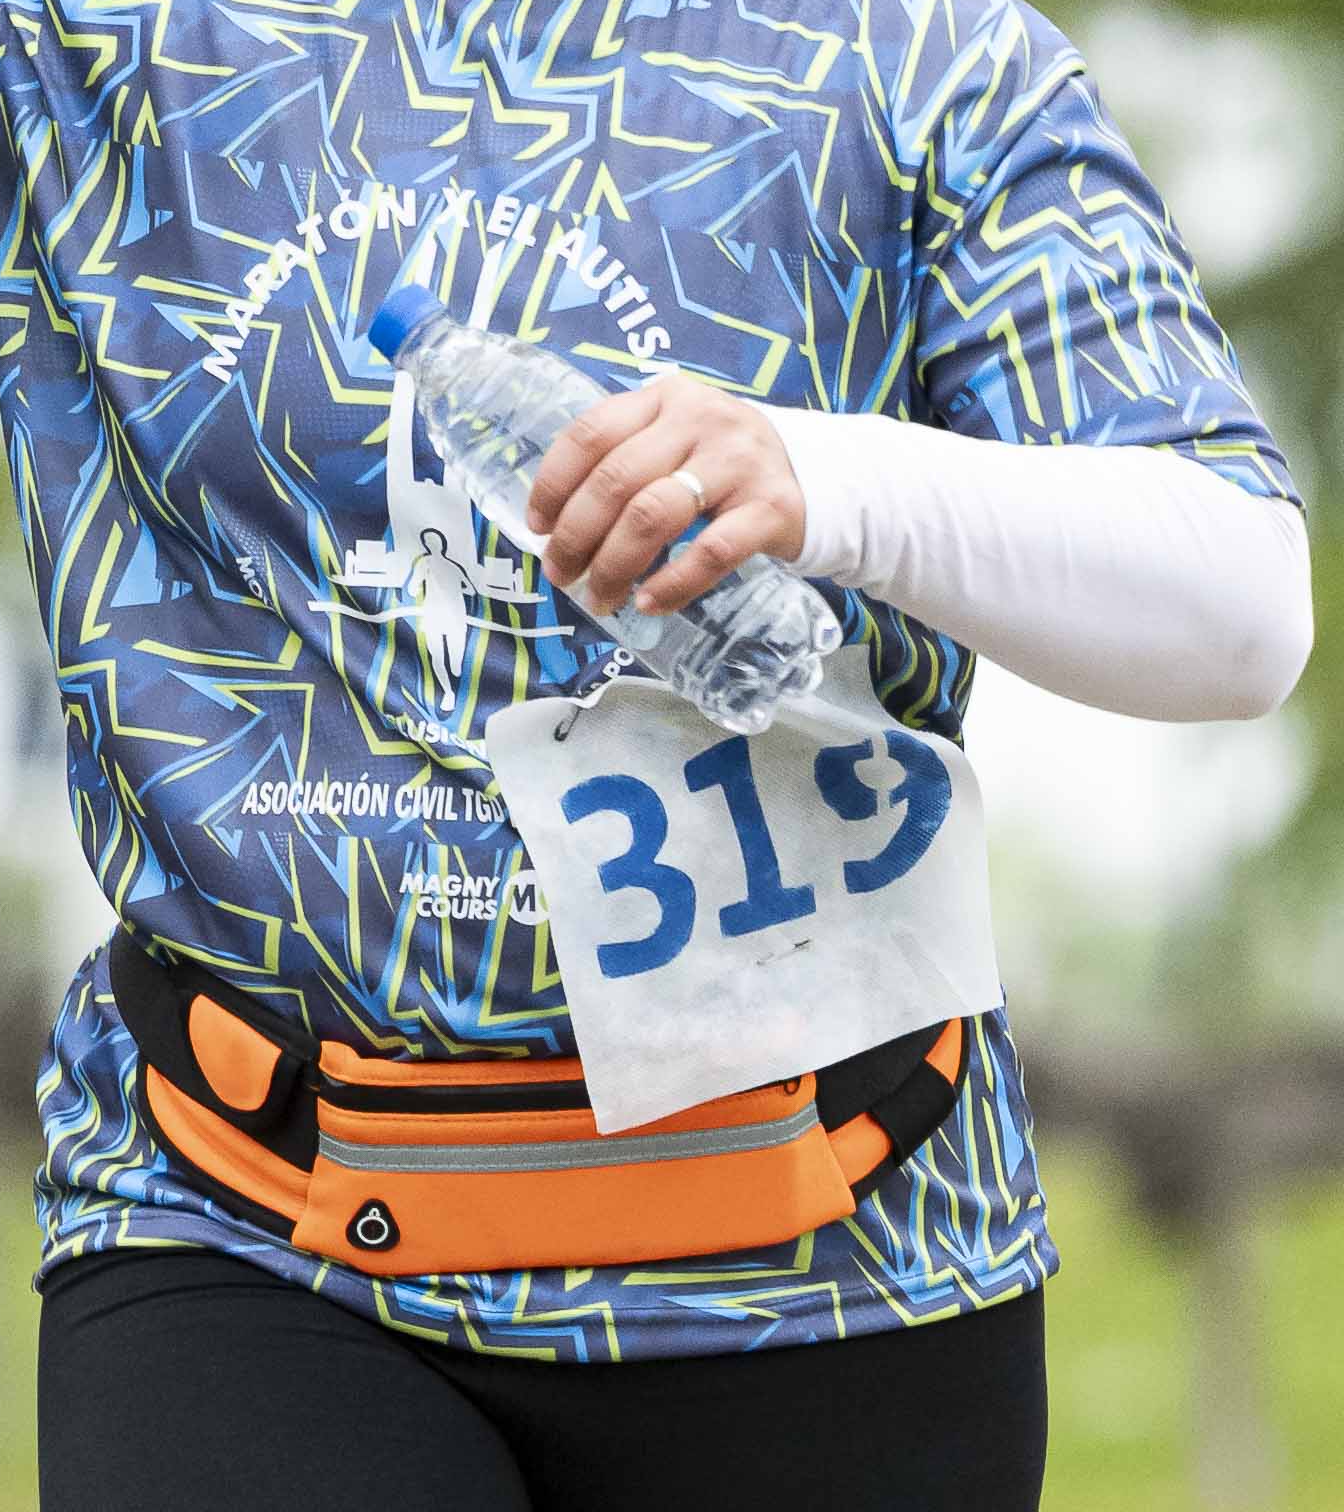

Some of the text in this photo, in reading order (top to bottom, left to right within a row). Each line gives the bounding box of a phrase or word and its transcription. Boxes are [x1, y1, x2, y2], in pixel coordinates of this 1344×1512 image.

[202, 188, 417, 384] MARATÓN
[435, 187, 476, 229] X
[486, 194, 536, 248] EL
[241, 772, 389, 817] ASOCIACIÓN
[394, 784, 458, 821] CIVIL
[560, 729, 952, 979] 319
[399, 873, 500, 897] MAGNY
[416, 896, 498, 920] COURS
